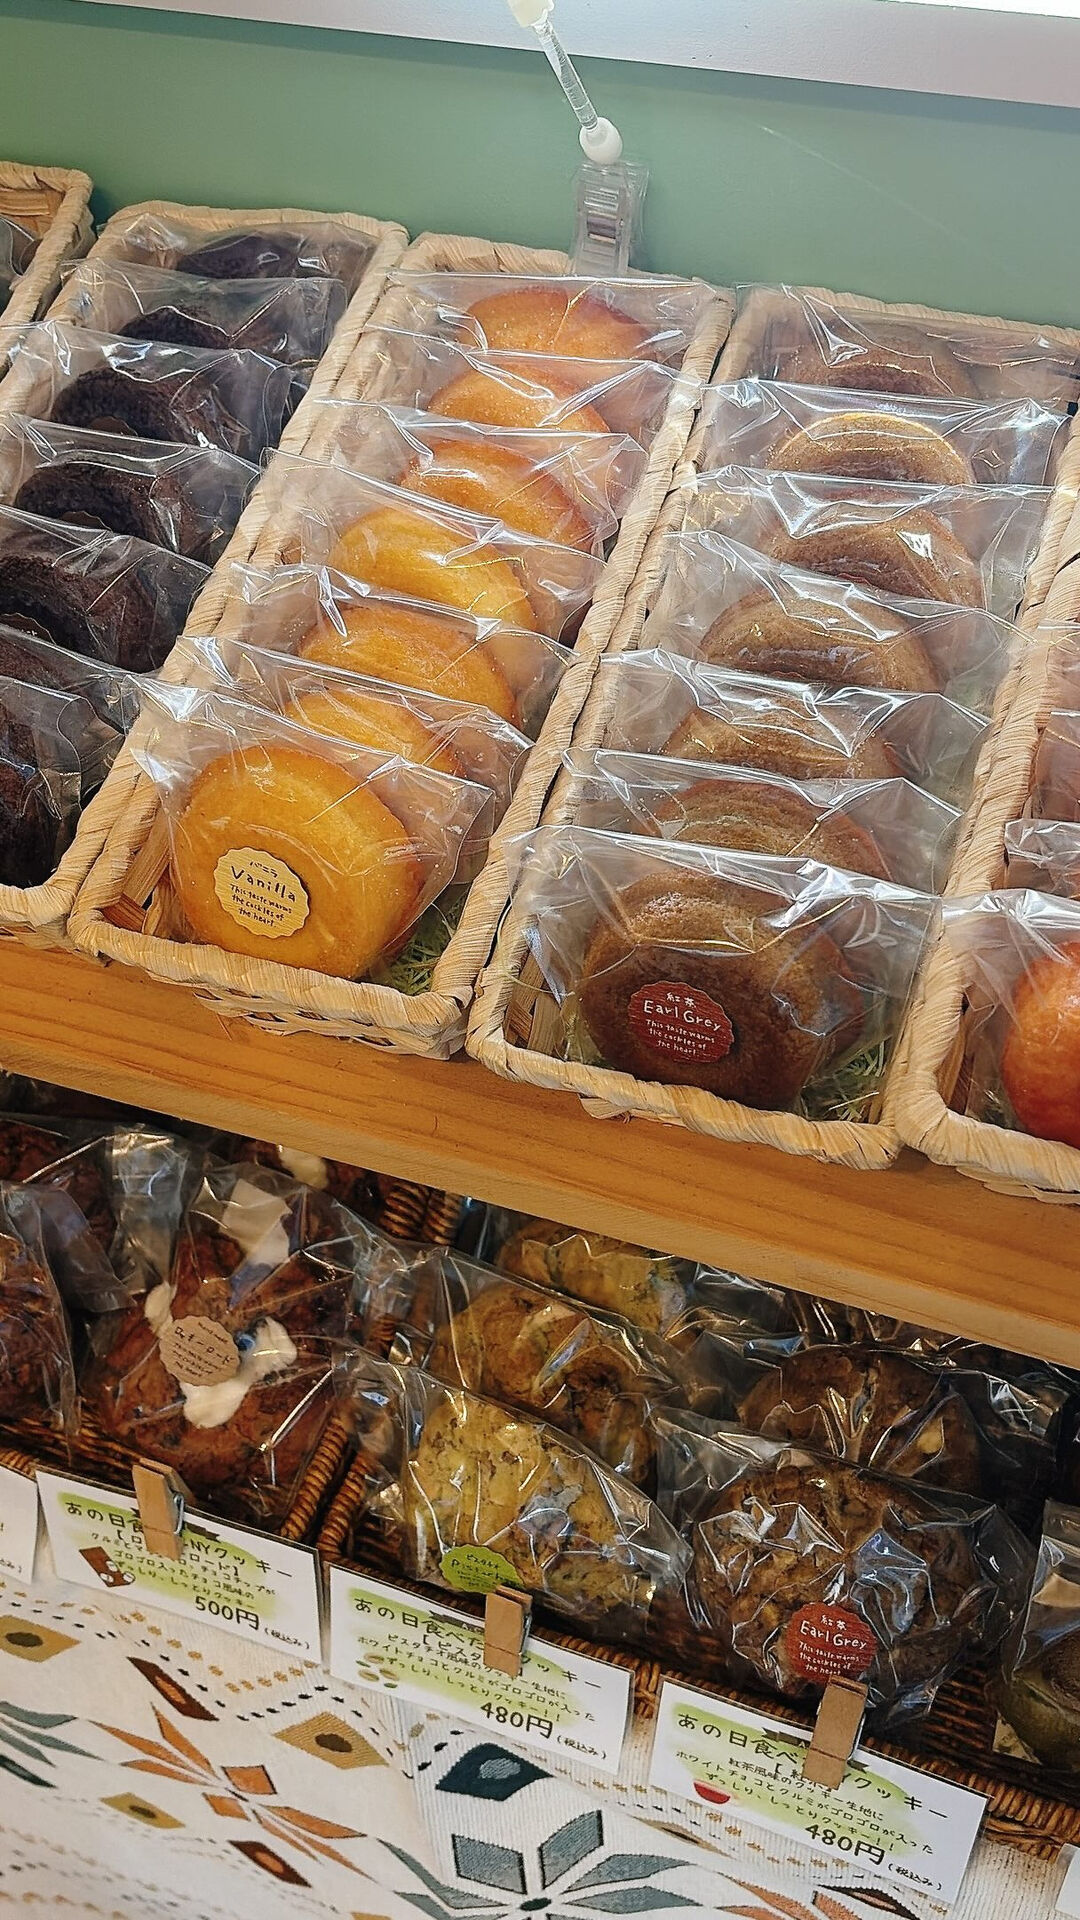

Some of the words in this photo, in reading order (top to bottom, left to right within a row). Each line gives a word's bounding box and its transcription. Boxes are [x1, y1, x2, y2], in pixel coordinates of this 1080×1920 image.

[249, 860, 278, 878] バニラ
[231, 865, 296, 903] Vanilla
[230, 883, 247, 895] This
[248, 890, 268, 904] taste
[268, 900, 293, 914] warms
[232, 894, 244, 905] the
[245, 900, 274, 917] cockles
[276, 913, 285, 922] of
[238, 907, 251, 918] the
[666, 992, 696, 1008] 紅茶
[643, 999, 679, 1018] Earl
[683, 1010, 722, 1032] Grey
[645, 1019, 663, 1029] This
[666, 1023, 688, 1036] taste
[688, 1031, 715, 1044] warms
[648, 1027, 662, 1037] the
[664, 1034, 696, 1047] cockles
[697, 1042, 706, 1050] of
[657, 1040, 671, 1049] the
[195, 1596, 260, 1631] 500円
[821, 1614, 847, 1631] 紅茶
[800, 1620, 829, 1642] Earl
[832, 1633, 867, 1650] Grey
[799, 1641, 814, 1653] This
[815, 1648, 835, 1659] taste
[799, 1652, 811, 1662] the
[843, 1662, 851, 1670] of
[805, 1663, 818, 1672] the
[480, 1702, 553, 1739] 480円
[556, 1735, 607, 1760] （税込み）
[728, 1757, 884, 1821] 紅茶風味のクッキー生地に
[805, 1824, 886, 1866] 480円
[888, 1863, 943, 1891] （税込み）
